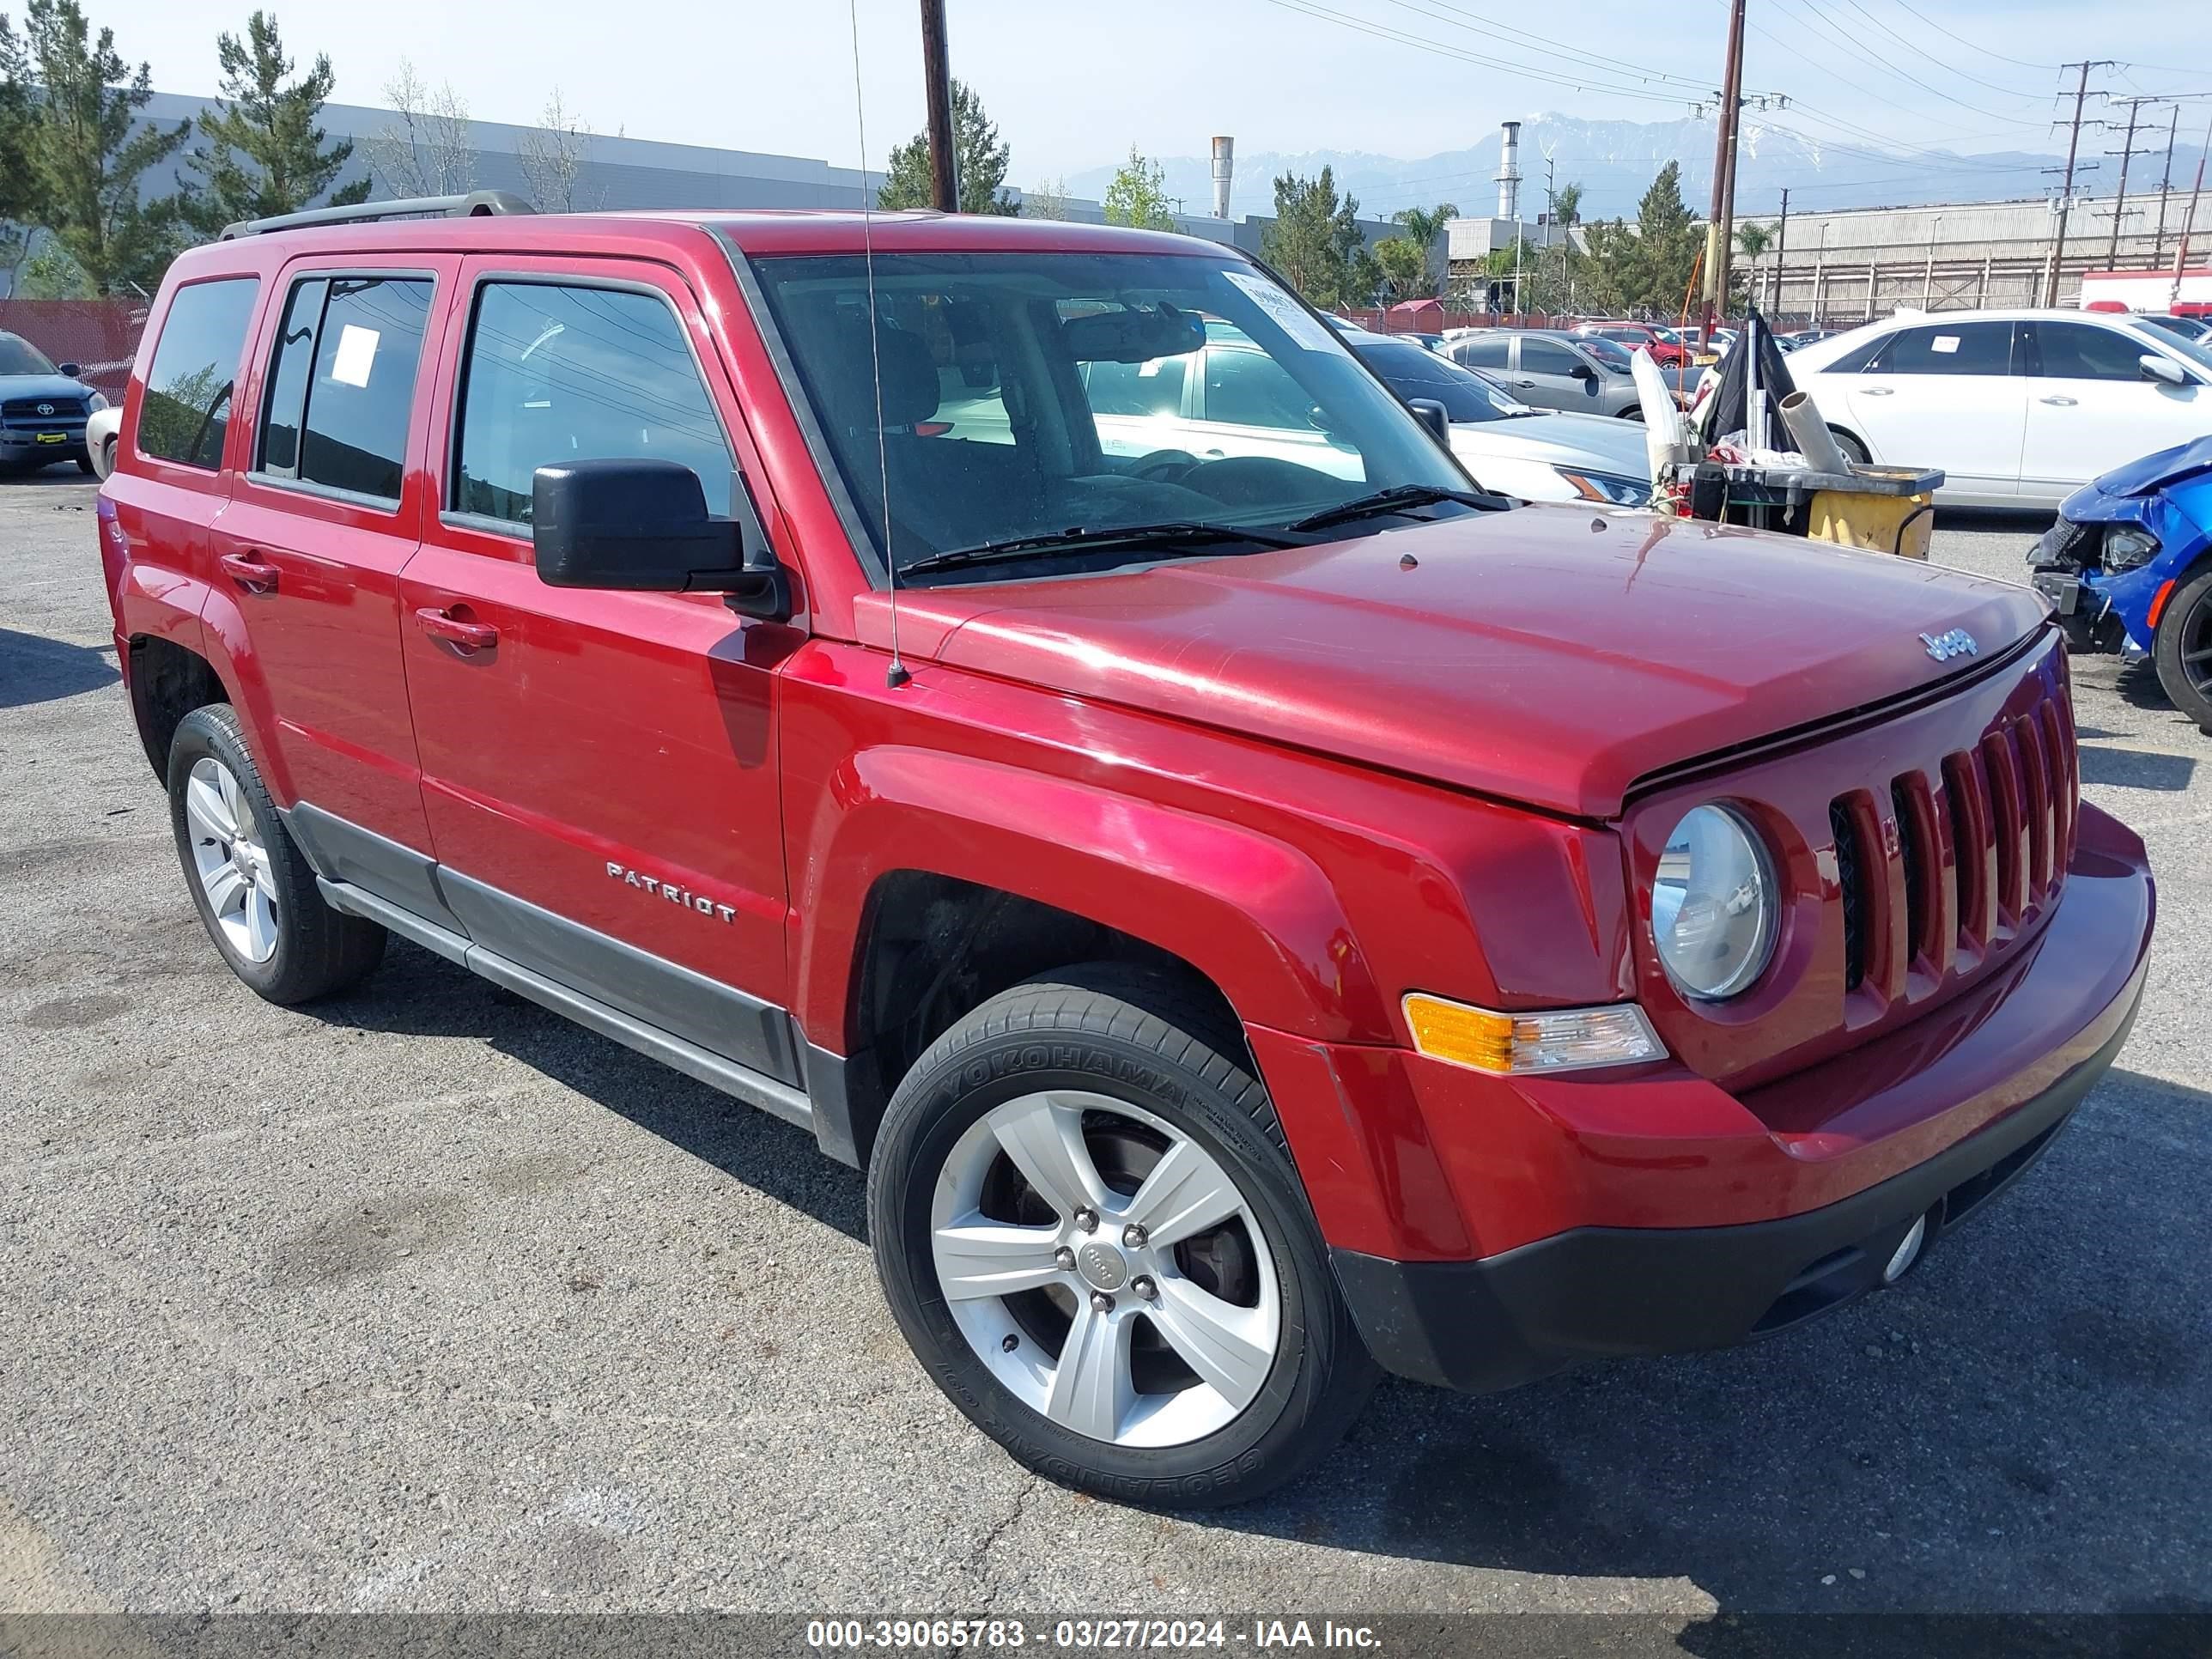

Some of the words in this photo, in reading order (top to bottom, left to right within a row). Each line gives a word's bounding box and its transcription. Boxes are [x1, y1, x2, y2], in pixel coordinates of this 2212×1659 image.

[1918, 628, 1978, 662] Jeep
[605, 861, 738, 924] PATRIOT
[939, 1044, 1188, 1110] YOKOHAMA
